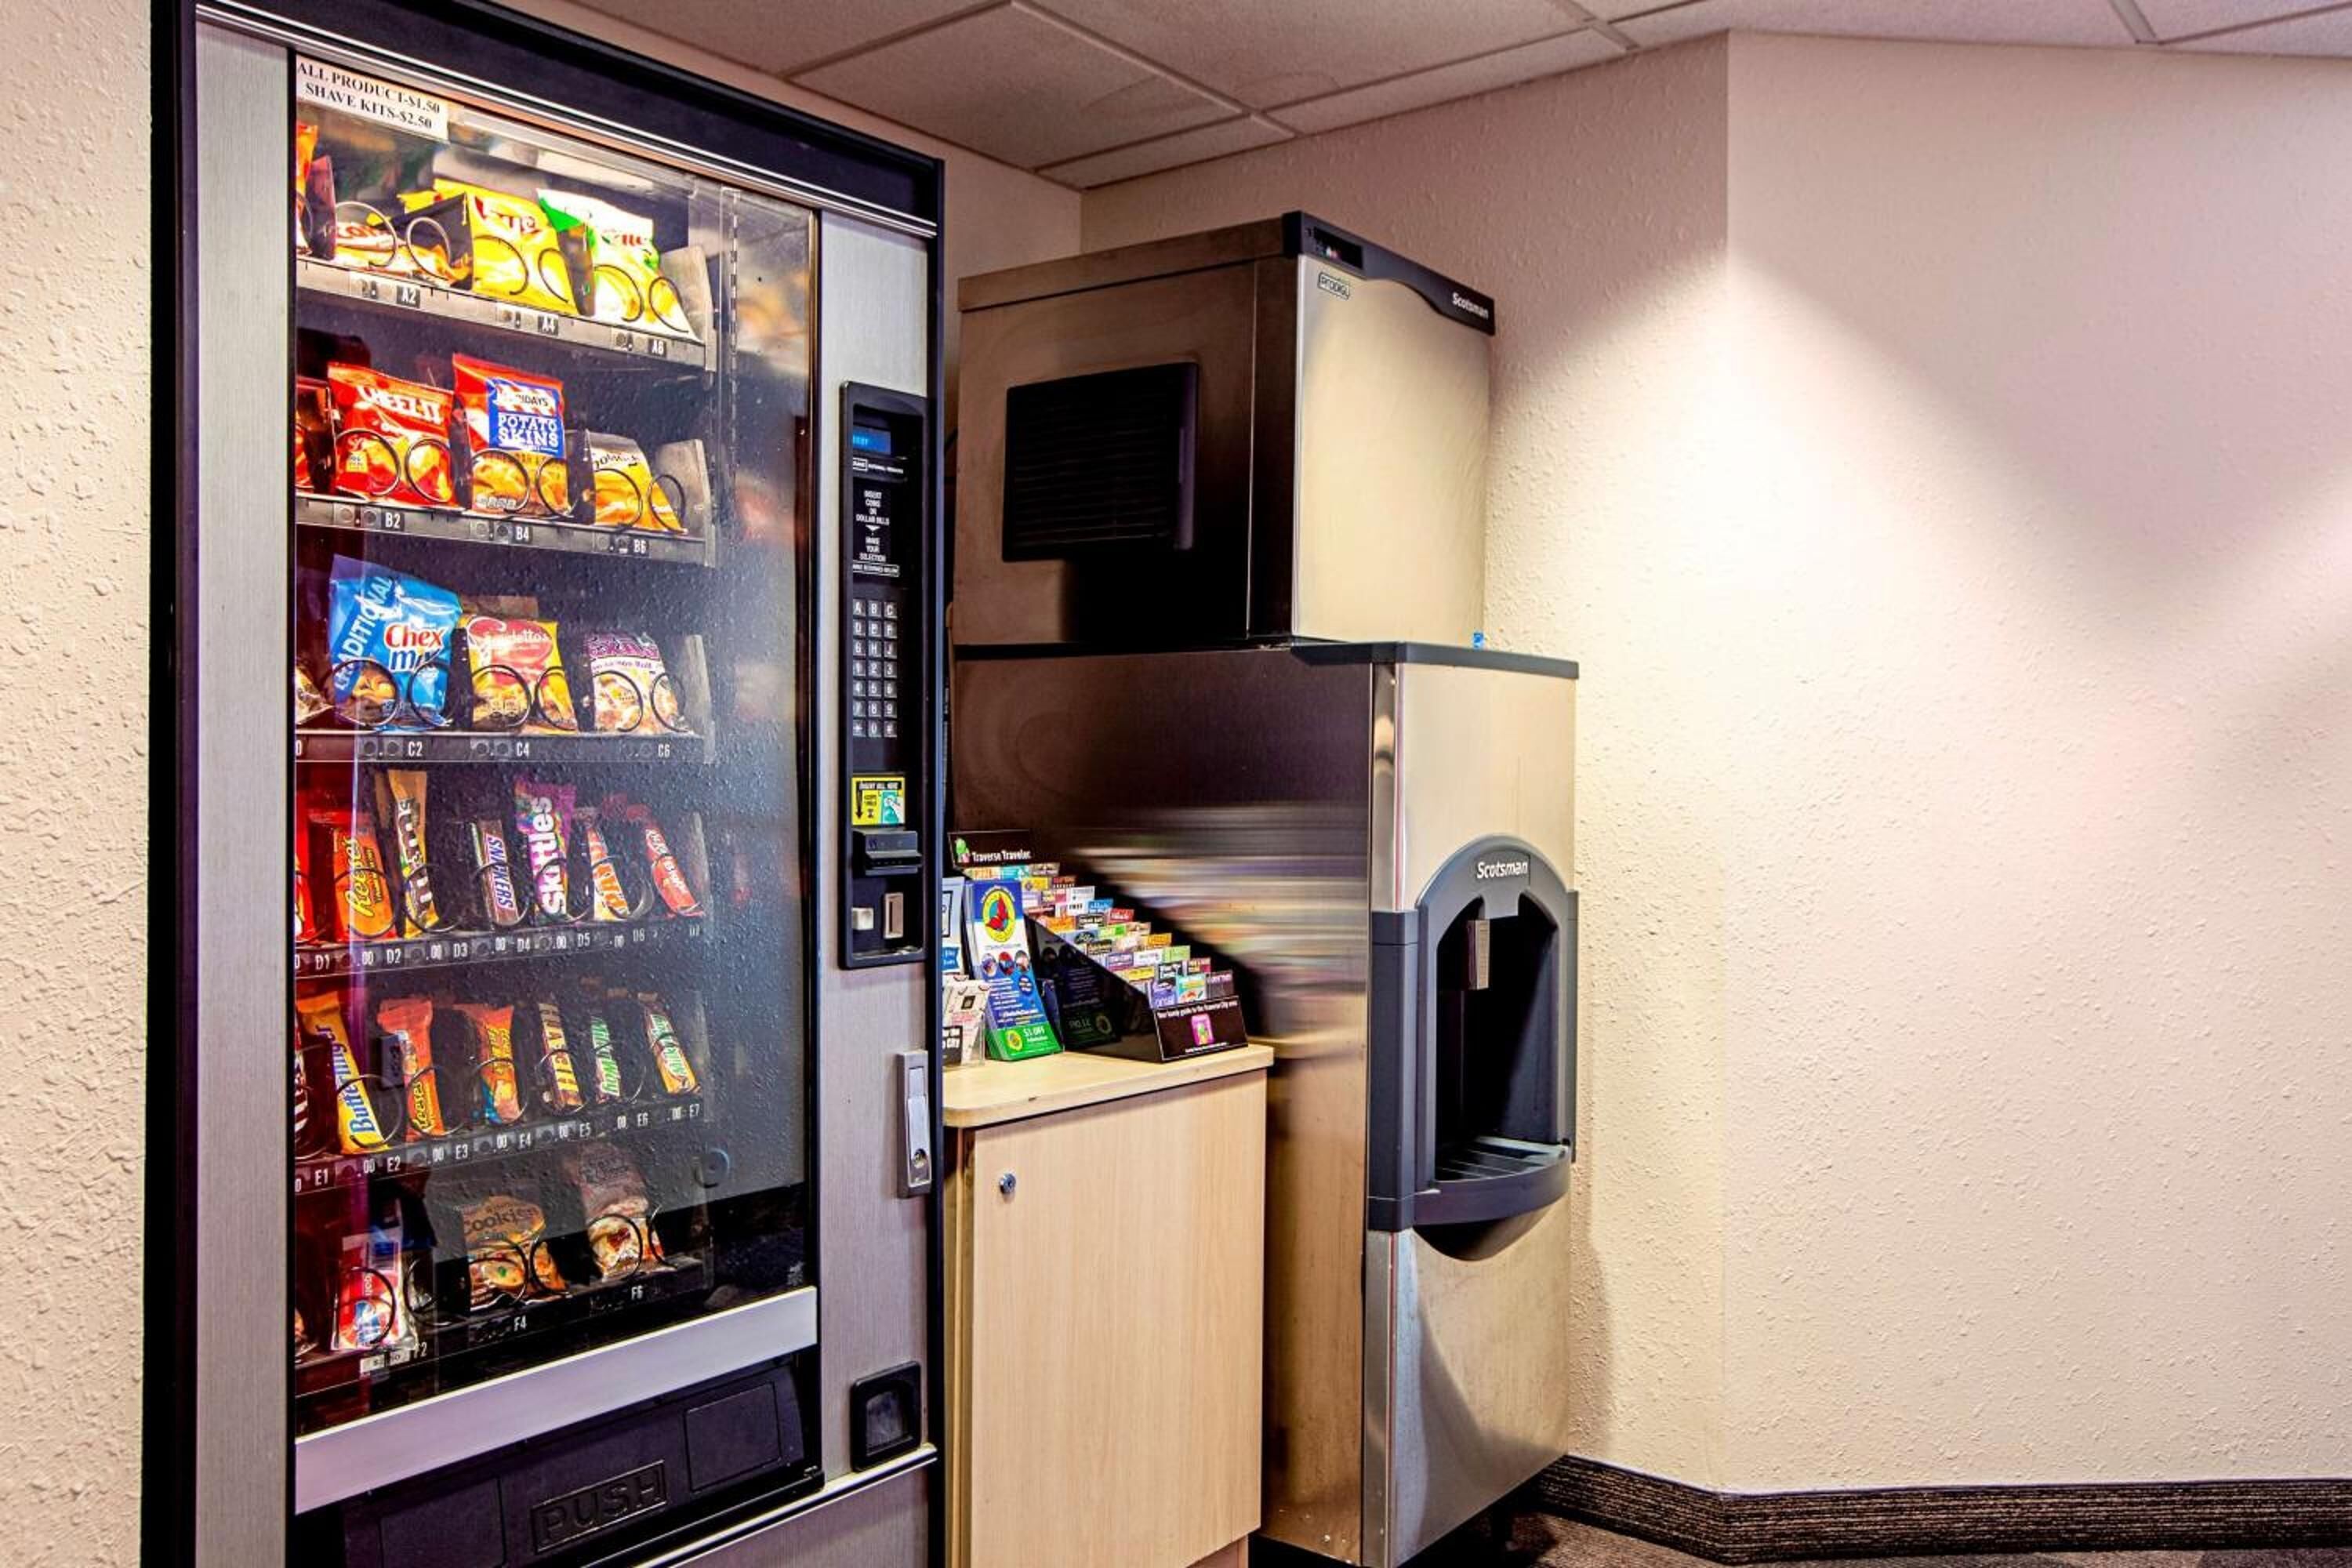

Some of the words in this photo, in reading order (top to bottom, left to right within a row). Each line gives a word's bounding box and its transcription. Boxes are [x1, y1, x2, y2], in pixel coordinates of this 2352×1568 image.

[298, 62, 327, 81] ALL
[306, 82, 356, 107] SHAVE
[401, 291, 417, 304] A2
[1452, 291, 1489, 319] Scotsman
[542, 318, 556, 332] A4
[498, 413, 557, 430] POTATO
[498, 427, 559, 448] SKINS
[385, 512, 401, 529] B2
[516, 527, 530, 541] B4
[633, 539, 647, 554] B6
[385, 624, 445, 648] Chex
[408, 741, 423, 757] C2
[517, 743, 529, 757] C4
[658, 744, 670, 757] C6
[528, 797, 567, 914] Skittles
[972, 850, 1002, 862] Traverse
[1002, 848, 1031, 861] Traveler
[1477, 861, 1528, 880] Scotsman
[517, 938, 531, 952] D4
[578, 933, 590, 948] D5
[387, 949, 401, 964] D2
[453, 942, 468, 957] D3
[539, 1003, 580, 1094] HEATH
[689, 1104, 699, 1117] E7
[637, 1112, 648, 1127] E6
[579, 1123, 590, 1138] E5
[520, 1133, 531, 1149] E4
[456, 1143, 469, 1159] E3
[387, 1156, 401, 1171] E2
[315, 1171, 328, 1186] E1
[514, 1316, 528, 1331] F4
[540, 1469, 660, 1545] PUSH
